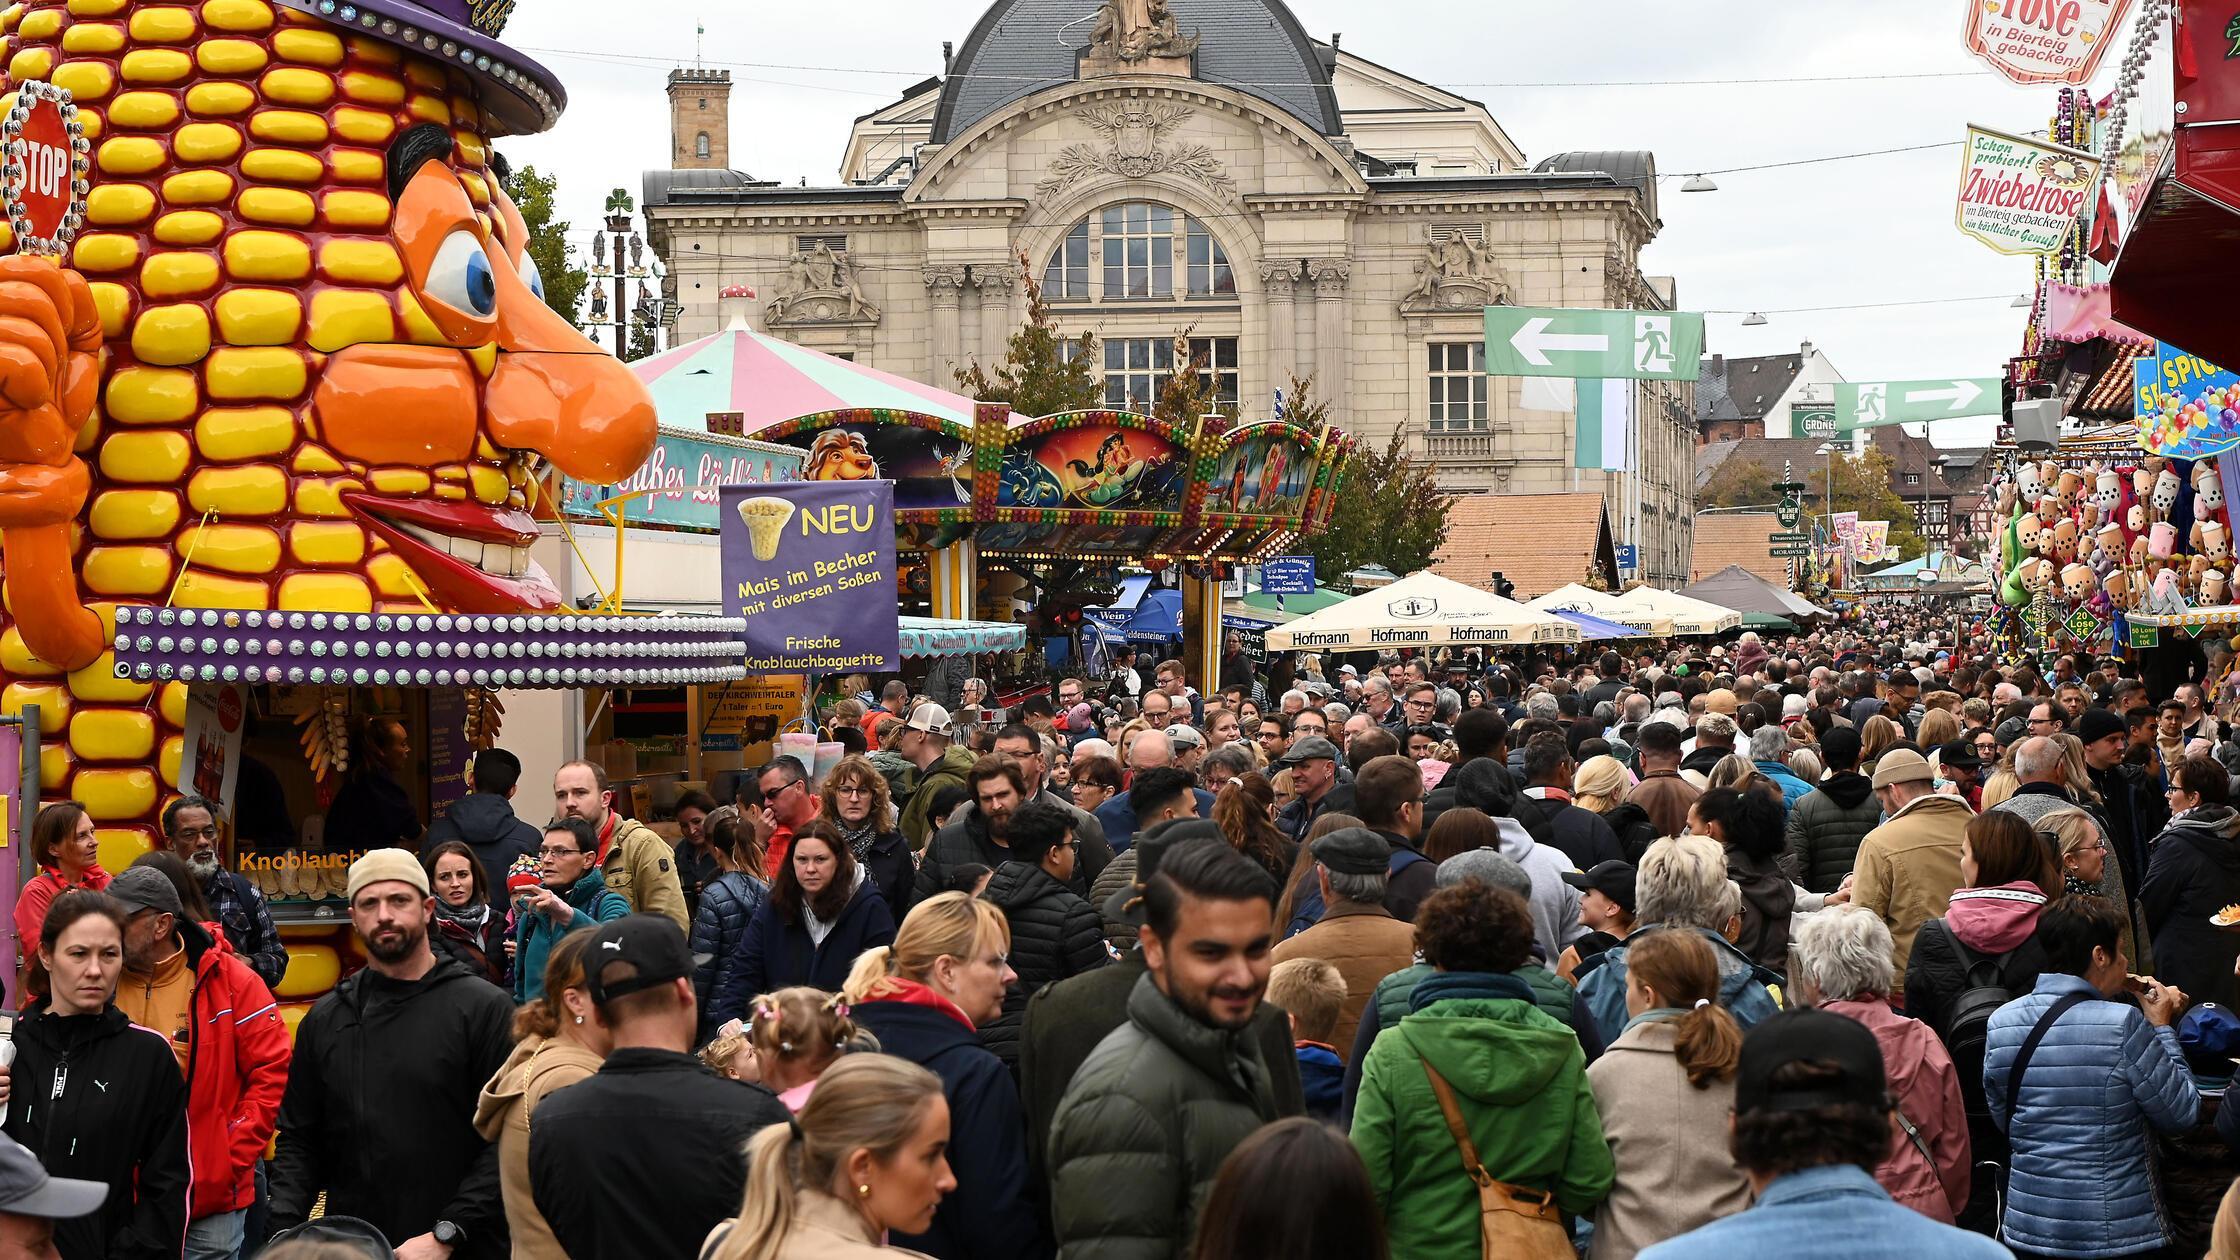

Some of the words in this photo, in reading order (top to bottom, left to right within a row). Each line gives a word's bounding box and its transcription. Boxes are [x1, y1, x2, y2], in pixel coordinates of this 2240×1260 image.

[1986, 23, 2003, 36] in
[2005, 27, 2068, 54] Bierteig
[1997, 41, 2081, 68] gebacken!
[1975, 136, 2013, 154] Schon
[9, 137, 67, 199] STOP
[1975, 150, 2038, 169] probiert?
[1960, 167, 2084, 218] Zwiebelrose
[1966, 205, 1977, 216] im
[1978, 205, 2011, 222] Bierteig
[2012, 212, 2065, 231] gebacken
[1978, 220, 2019, 238] köstlicher
[2020, 228, 2058, 249] Genuß
[801, 504, 875, 536] NEU
[738, 577, 780, 599] Mais
[787, 571, 809, 586] im
[814, 550, 877, 578] Becher
[742, 601, 766, 616] mit
[772, 583, 833, 609] diversen
[838, 570, 882, 591] Soßen
[1100, 611, 1125, 620] Wein
[2070, 620, 2094, 628] Lose
[1292, 631, 1350, 646] Hofmann
[1371, 628, 1429, 642] Hofmann
[1450, 625, 1508, 641] Hofmann
[2076, 628, 2089, 636] 5€
[786, 635, 841, 650] Frische
[744, 653, 884, 672] Knoblauchbaguette
[725, 690, 796, 700] KIRCHWEIHTALER
[730, 703, 748, 711] Taler
[765, 702, 784, 711] Euro
